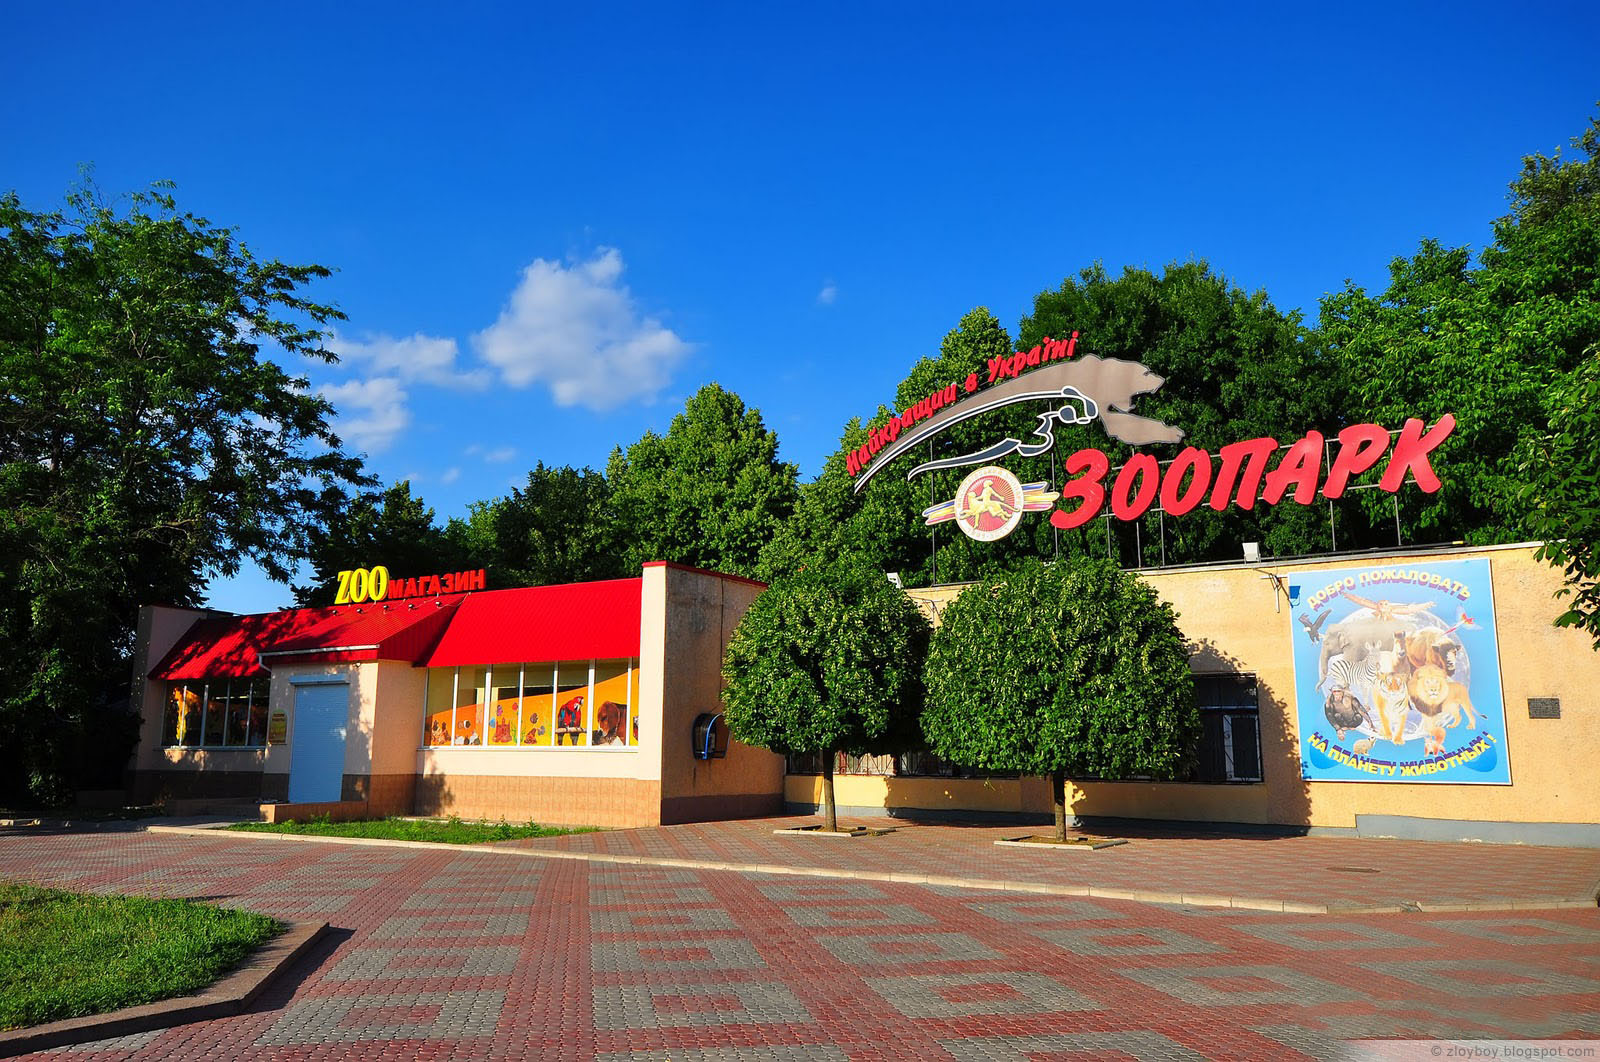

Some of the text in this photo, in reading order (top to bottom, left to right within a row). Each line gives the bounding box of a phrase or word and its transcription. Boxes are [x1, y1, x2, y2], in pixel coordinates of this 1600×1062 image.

[965, 373, 979, 393] в
[987, 331, 1079, 383] Україні
[1050, 413, 1456, 530] ЗООПАРК
[1307, 569, 1471, 610] ДОБРО ПОЖАЛОВАТЬ
[1307, 732, 1328, 753] НА
[1328, 745, 1397, 776] ПЛАНЕТУ
